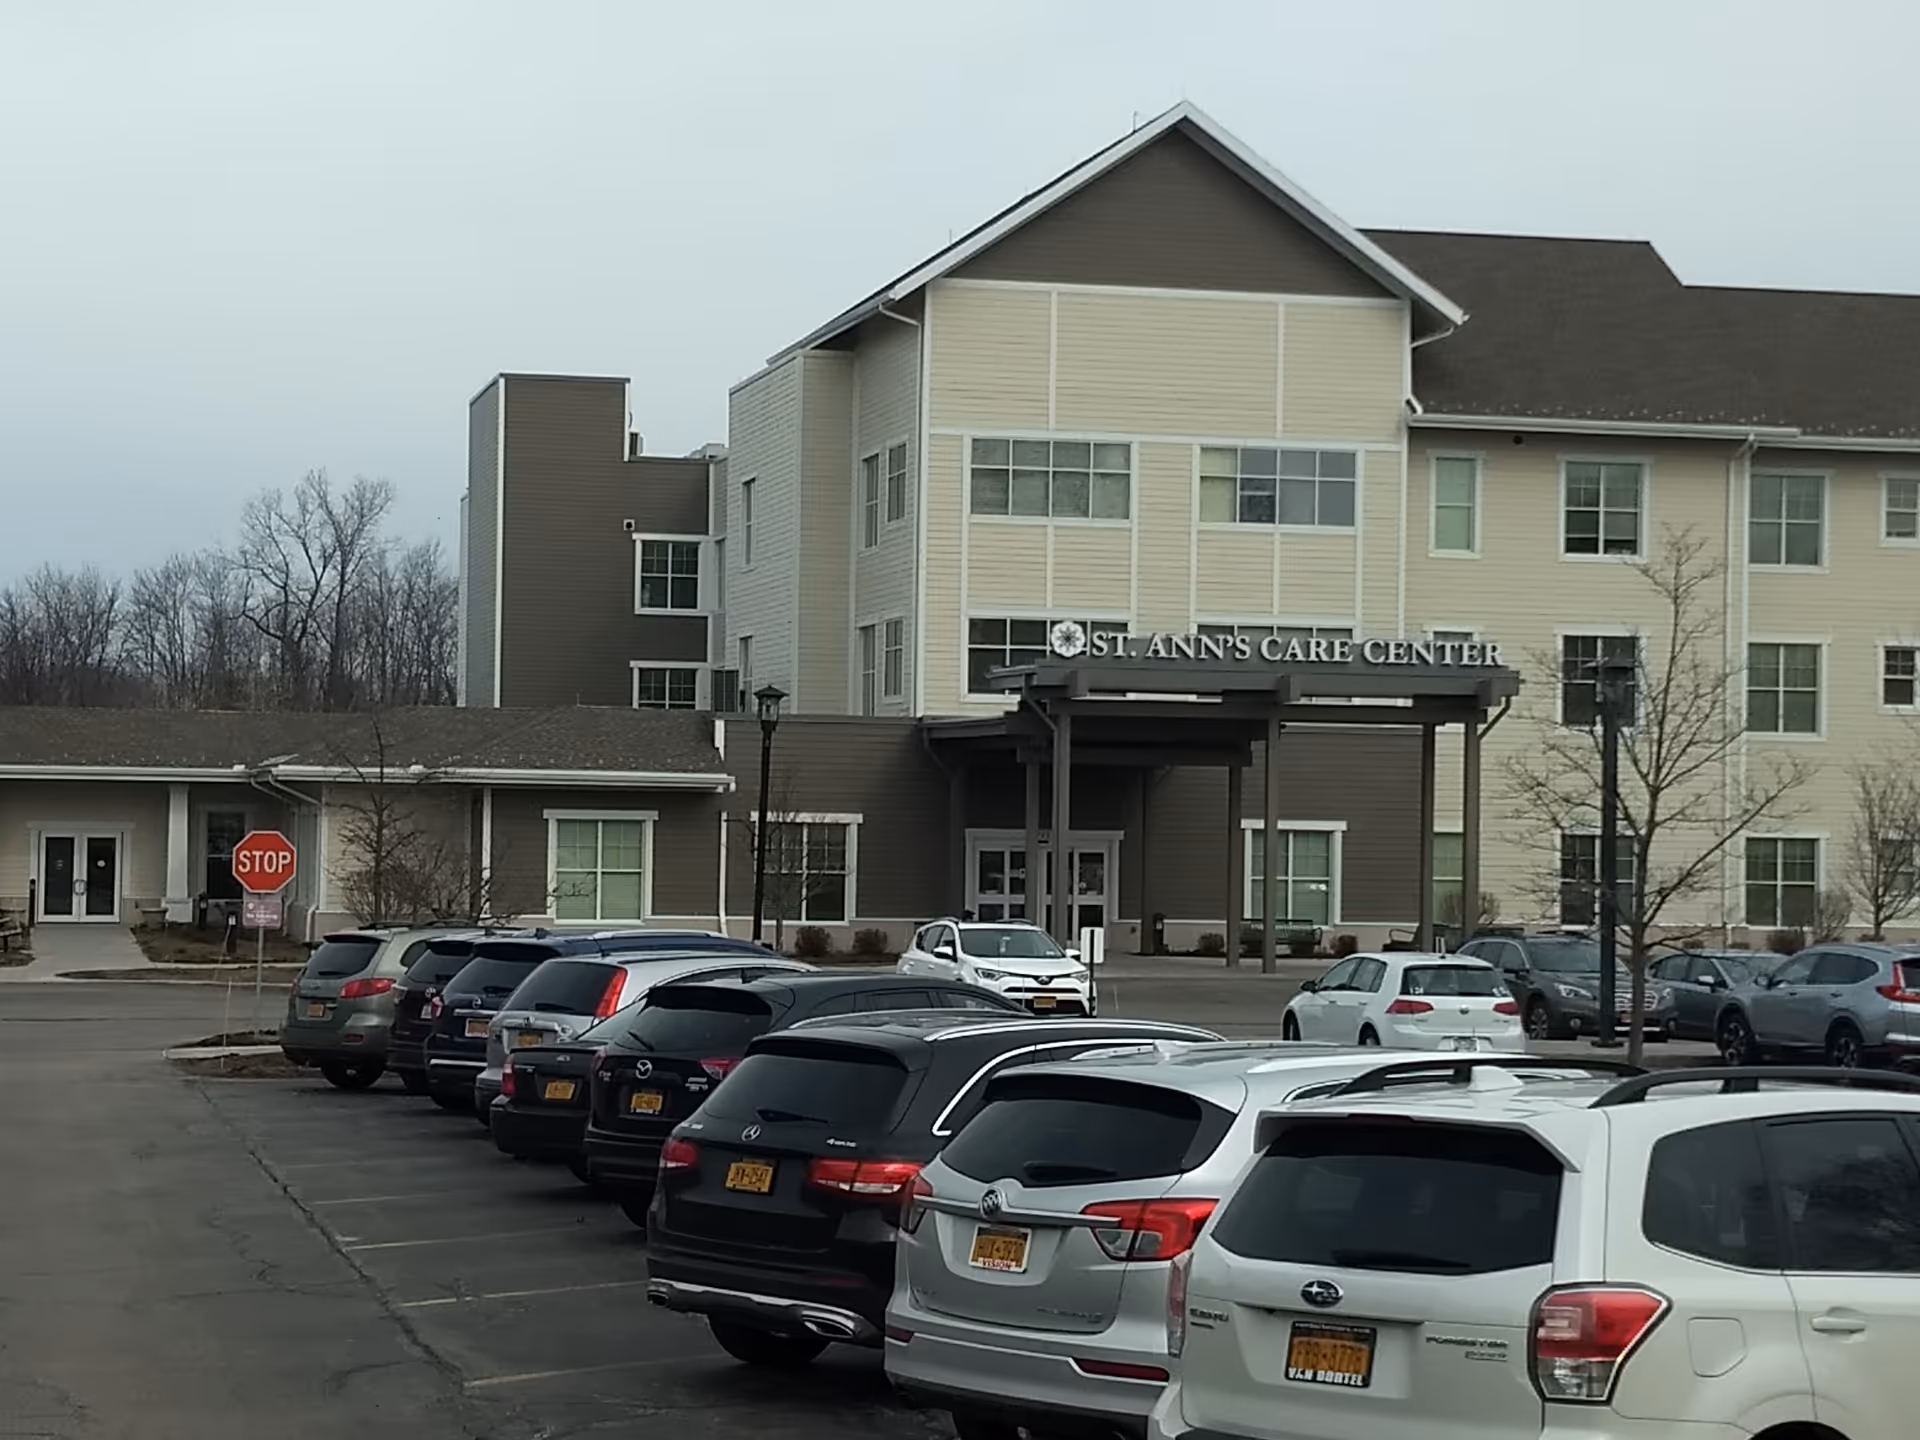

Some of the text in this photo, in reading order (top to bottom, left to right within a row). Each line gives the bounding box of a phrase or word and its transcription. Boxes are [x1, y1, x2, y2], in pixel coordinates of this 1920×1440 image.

[1092, 630, 1509, 667] ST. ANN'S CARE CENTER
[238, 850, 292, 874] STOP
[1287, 1367, 1314, 1381] VAN
